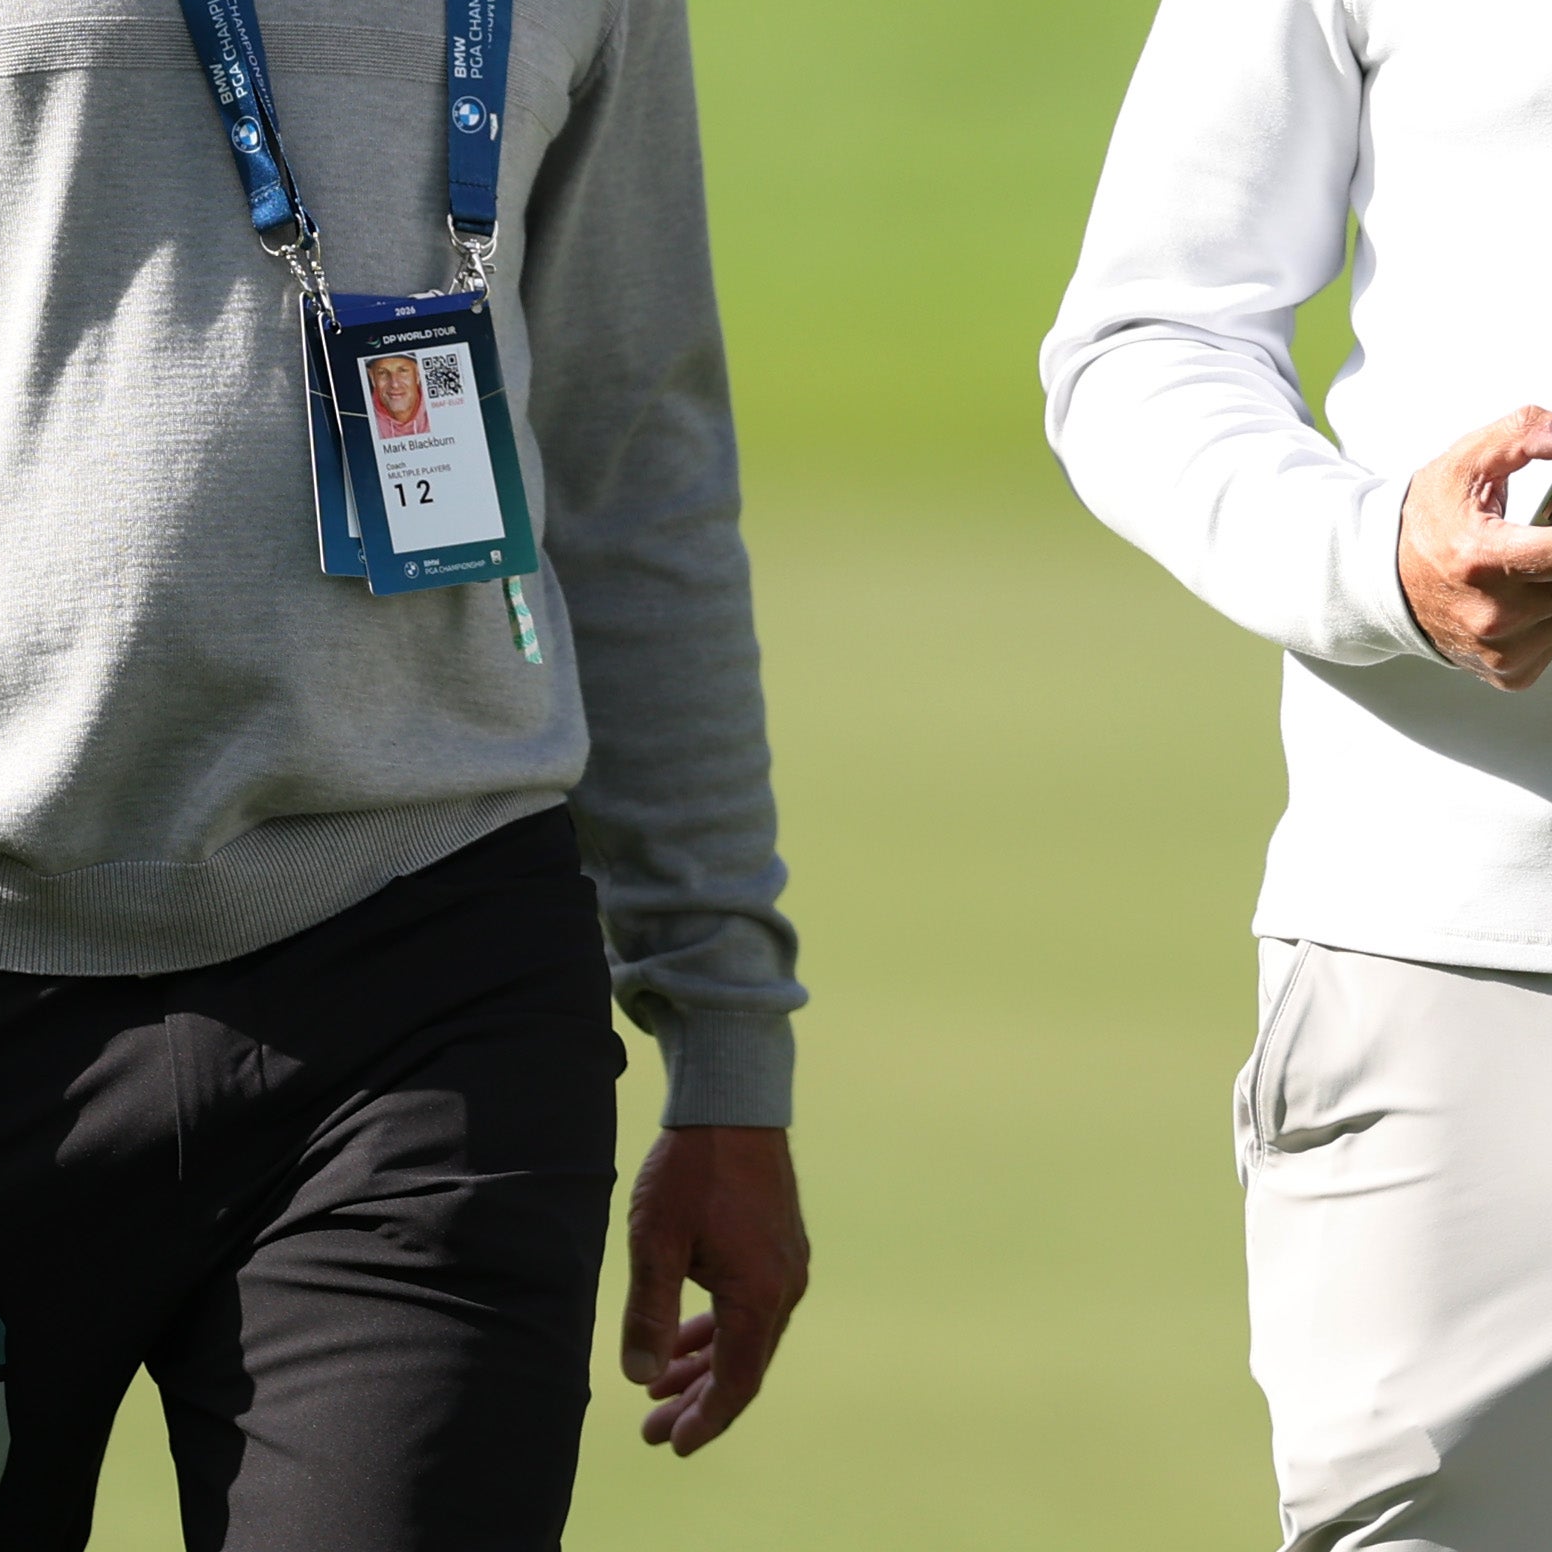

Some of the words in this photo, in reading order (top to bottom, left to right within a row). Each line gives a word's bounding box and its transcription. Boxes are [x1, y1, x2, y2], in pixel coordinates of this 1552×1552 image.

[453, 36, 467, 79] BMW
[470, 45, 483, 80] PGA
[209, 63, 234, 105] BMW
[228, 61, 248, 99] PGA
[394, 306, 416, 317] 2026
[382, 335, 397, 345] DP
[397, 330, 433, 343] WORLD
[433, 325, 457, 338] TOUR
[383, 443, 407, 454] Mark
[408, 436, 455, 451] Blackburn
[386, 462, 406, 470] Coach
[388, 468, 421, 479] MULTIPLE
[421, 464, 451, 475] PLAYERS
[394, 483, 407, 507] 1
[416, 479, 434, 504] 2
